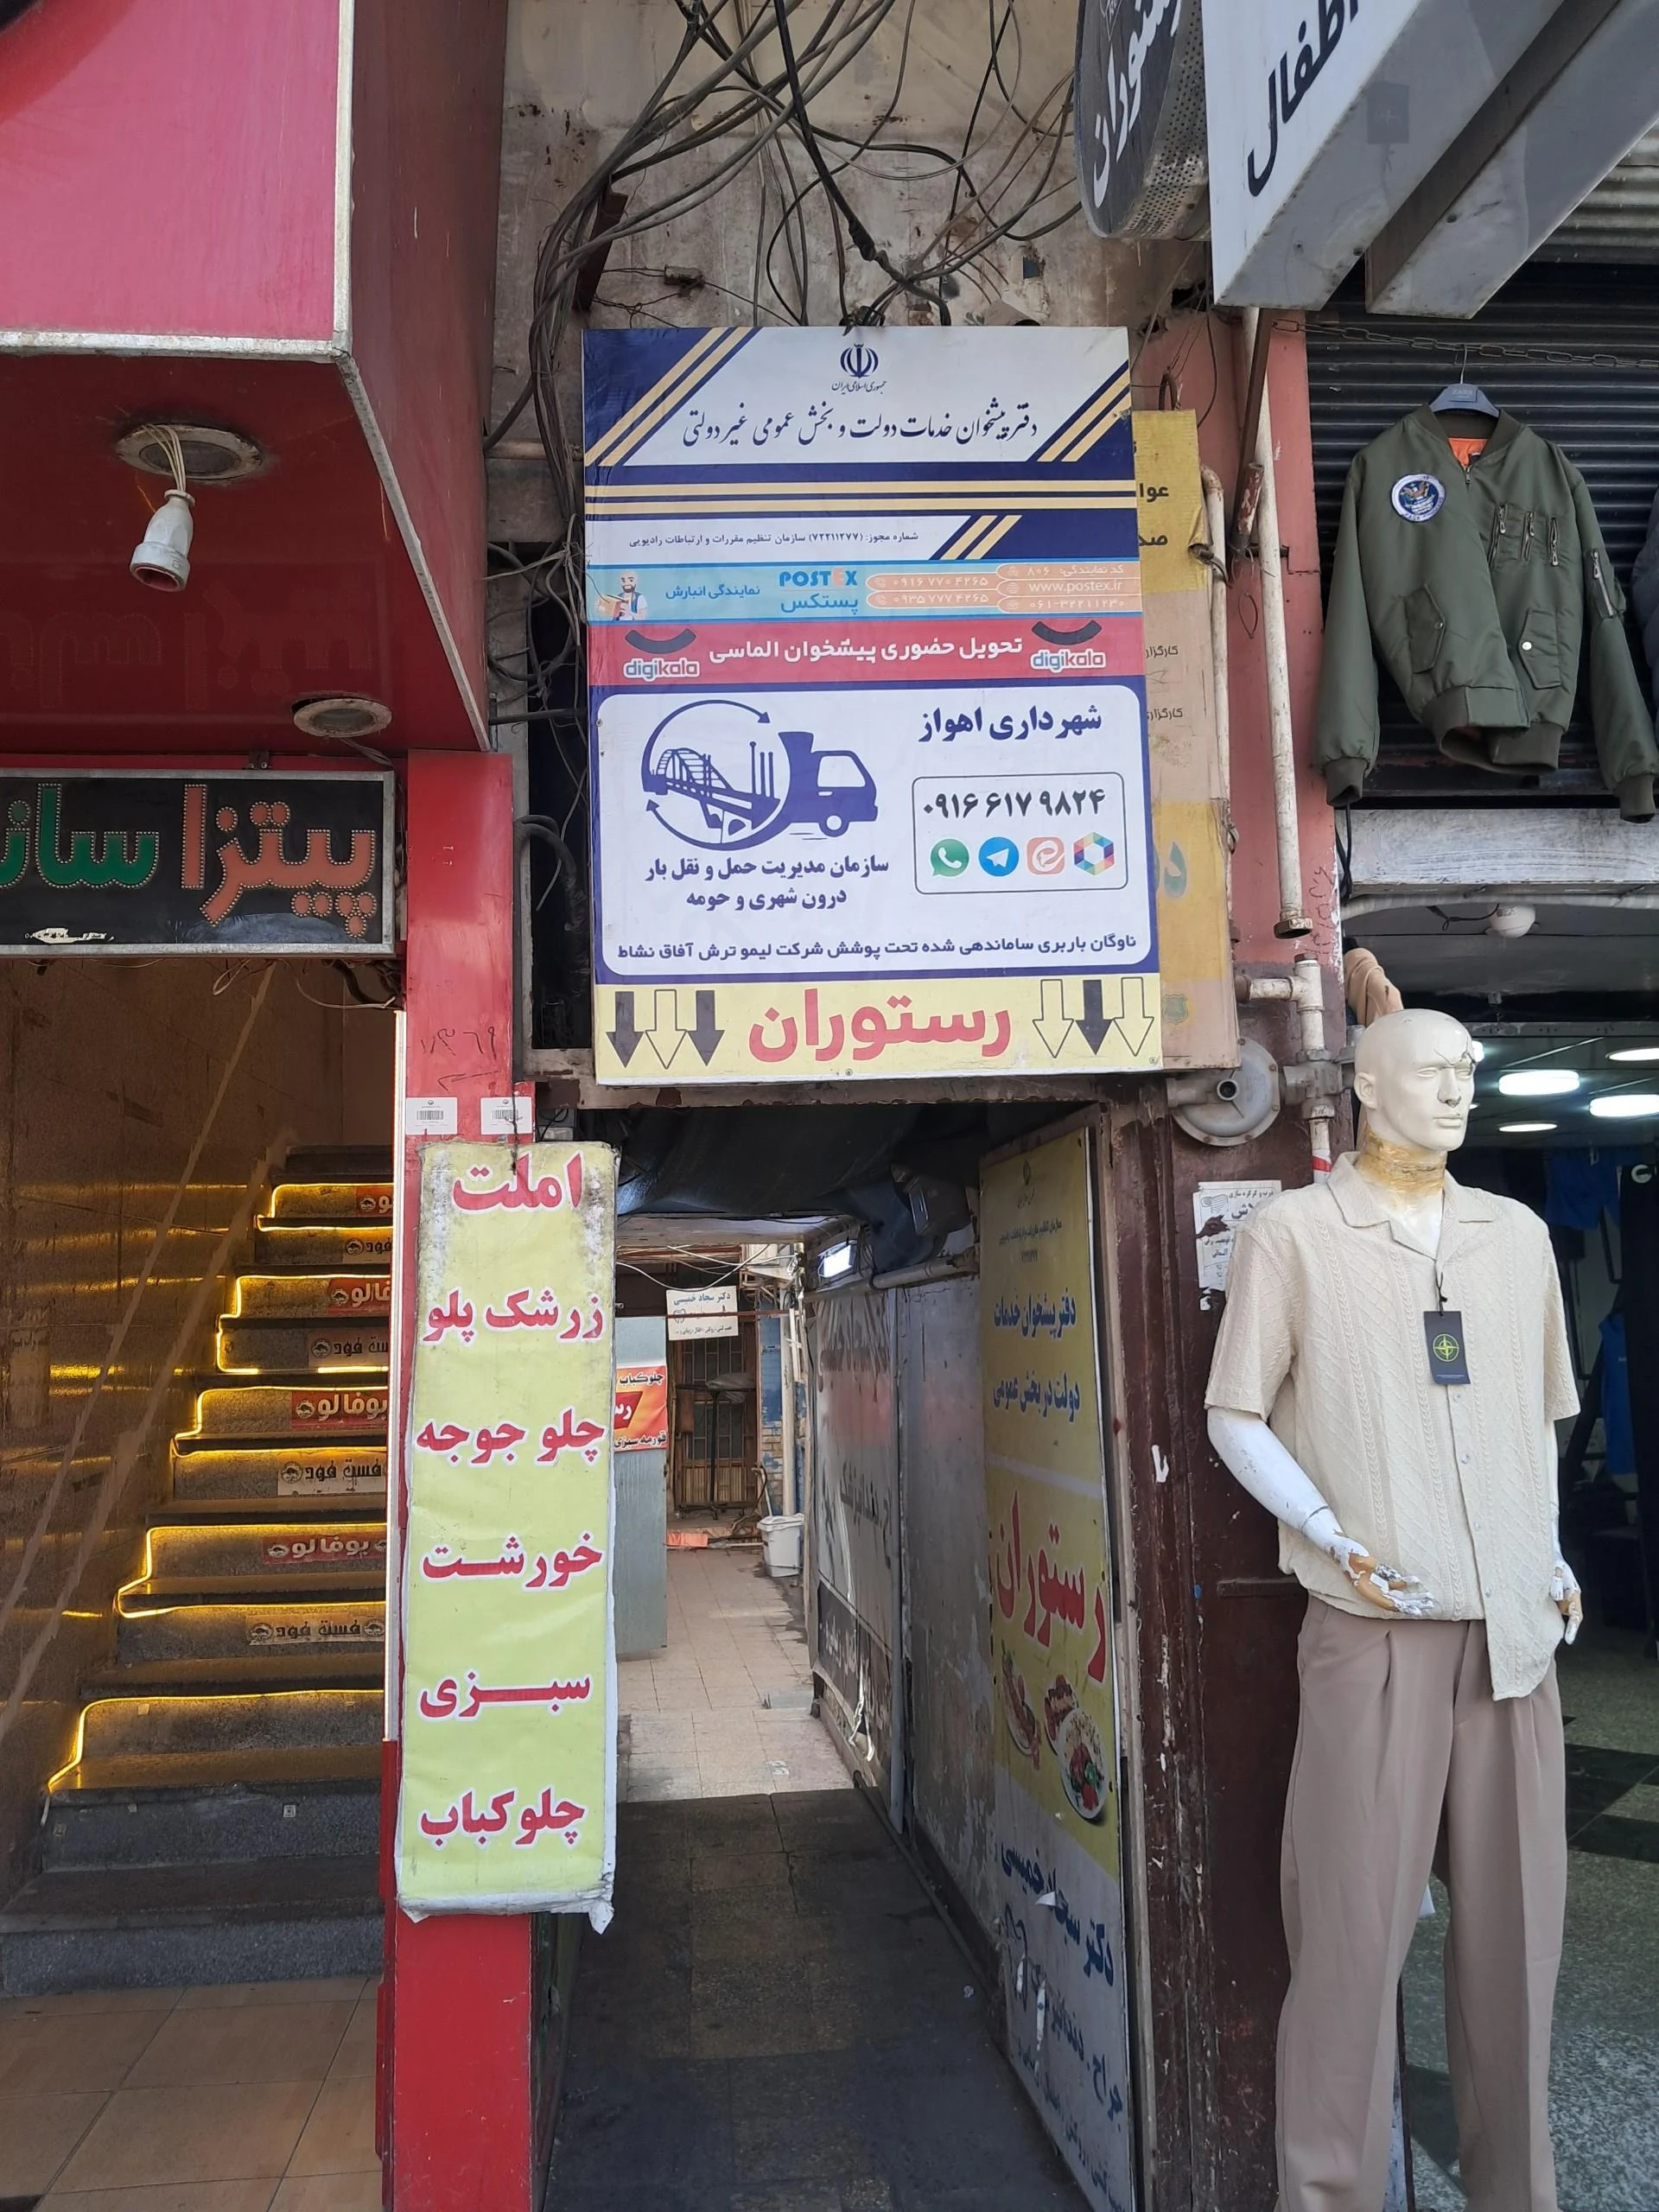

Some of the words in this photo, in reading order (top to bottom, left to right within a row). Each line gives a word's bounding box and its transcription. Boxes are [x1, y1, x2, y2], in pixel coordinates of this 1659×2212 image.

[753, 411, 794, 445] عمومی
[798, 400, 834, 445] بخش
[837, 423, 846, 438] و
[849, 412, 897, 437] دولت
[900, 413, 952, 437] خدمات
[629, 536, 663, 548] رادیویی
[664, 535, 702, 546] ارتباطات
[713, 535, 744, 546] مقررات
[746, 534, 772, 546] تنظیم
[774, 534, 805, 546] سازمان
[893, 532, 918, 543] شماره
[779, 567, 858, 588] POSTEX
[1110, 563, 1125, 575] کد
[664, 583, 707, 601] انبارش
[708, 585, 760, 599] نمایندگی
[1028, 579, 1123, 595] www.postex.ir
[780, 594, 859, 616] پستکس
[709, 640, 778, 664] الماسی
[785, 640, 876, 665] پیشخوان
[881, 640, 955, 662] حضوری
[959, 638, 1023, 660] تحویل
[1032, 648, 1105, 671] digikala
[625, 659, 699, 682] digikala
[918, 707, 982, 742] اهواز
[989, 705, 1102, 740] شهرداری
[923, 791, 978, 818] ۰۹۱۶
[986, 791, 1032, 817] ۶۱۷
[1039, 788, 1105, 817] ۹۸۲۴
[180, 783, 378, 938] پیتزا
[645, 858, 666, 881] بار
[671, 857, 699, 880] نقل
[718, 857, 757, 880] حمل
[761, 859, 825, 879] مدیریت
[830, 855, 889, 878] سازمان
[704, 866, 713, 880] و
[686, 892, 730, 911] حومه
[735, 897, 744, 910] و
[749, 887, 798, 910] شهری
[802, 889, 847, 909] درون
[618, 945, 654, 958] نشاط
[659, 942, 694, 958] آفاق
[698, 944, 736, 962] ترش
[741, 944, 772, 958] لیمو
[776, 942, 823, 957] شرکت
[827, 940, 880, 960] پوشش
[885, 941, 918, 953] تحت
[922, 939, 955, 952] شده
[959, 938, 1034, 955] ساماندهی
[1090, 934, 1136, 952] ناوگان
[749, 988, 1011, 1063] رستوران
[453, 1153, 582, 1213] املت
[716, 1291, 731, 1303] دکتر
[995, 1287, 1020, 1327] خدمات
[423, 1291, 474, 1344] پلو
[486, 1287, 604, 1342] زرشک
[1057, 1287, 1076, 1338] دفتر
[416, 1418, 525, 1465] جوجه
[538, 1408, 605, 1465] چلو
[305, 1459, 337, 1482] فود
[342, 1459, 382, 1478] فست
[422, 1533, 603, 1589] خورشت
[995, 1490, 1108, 1685] رستوران
[276, 1620, 311, 1639] فود
[318, 1619, 360, 1637] فست
[420, 1669, 592, 1720] سبزی
[1084, 1917, 1114, 1986] دکتر
